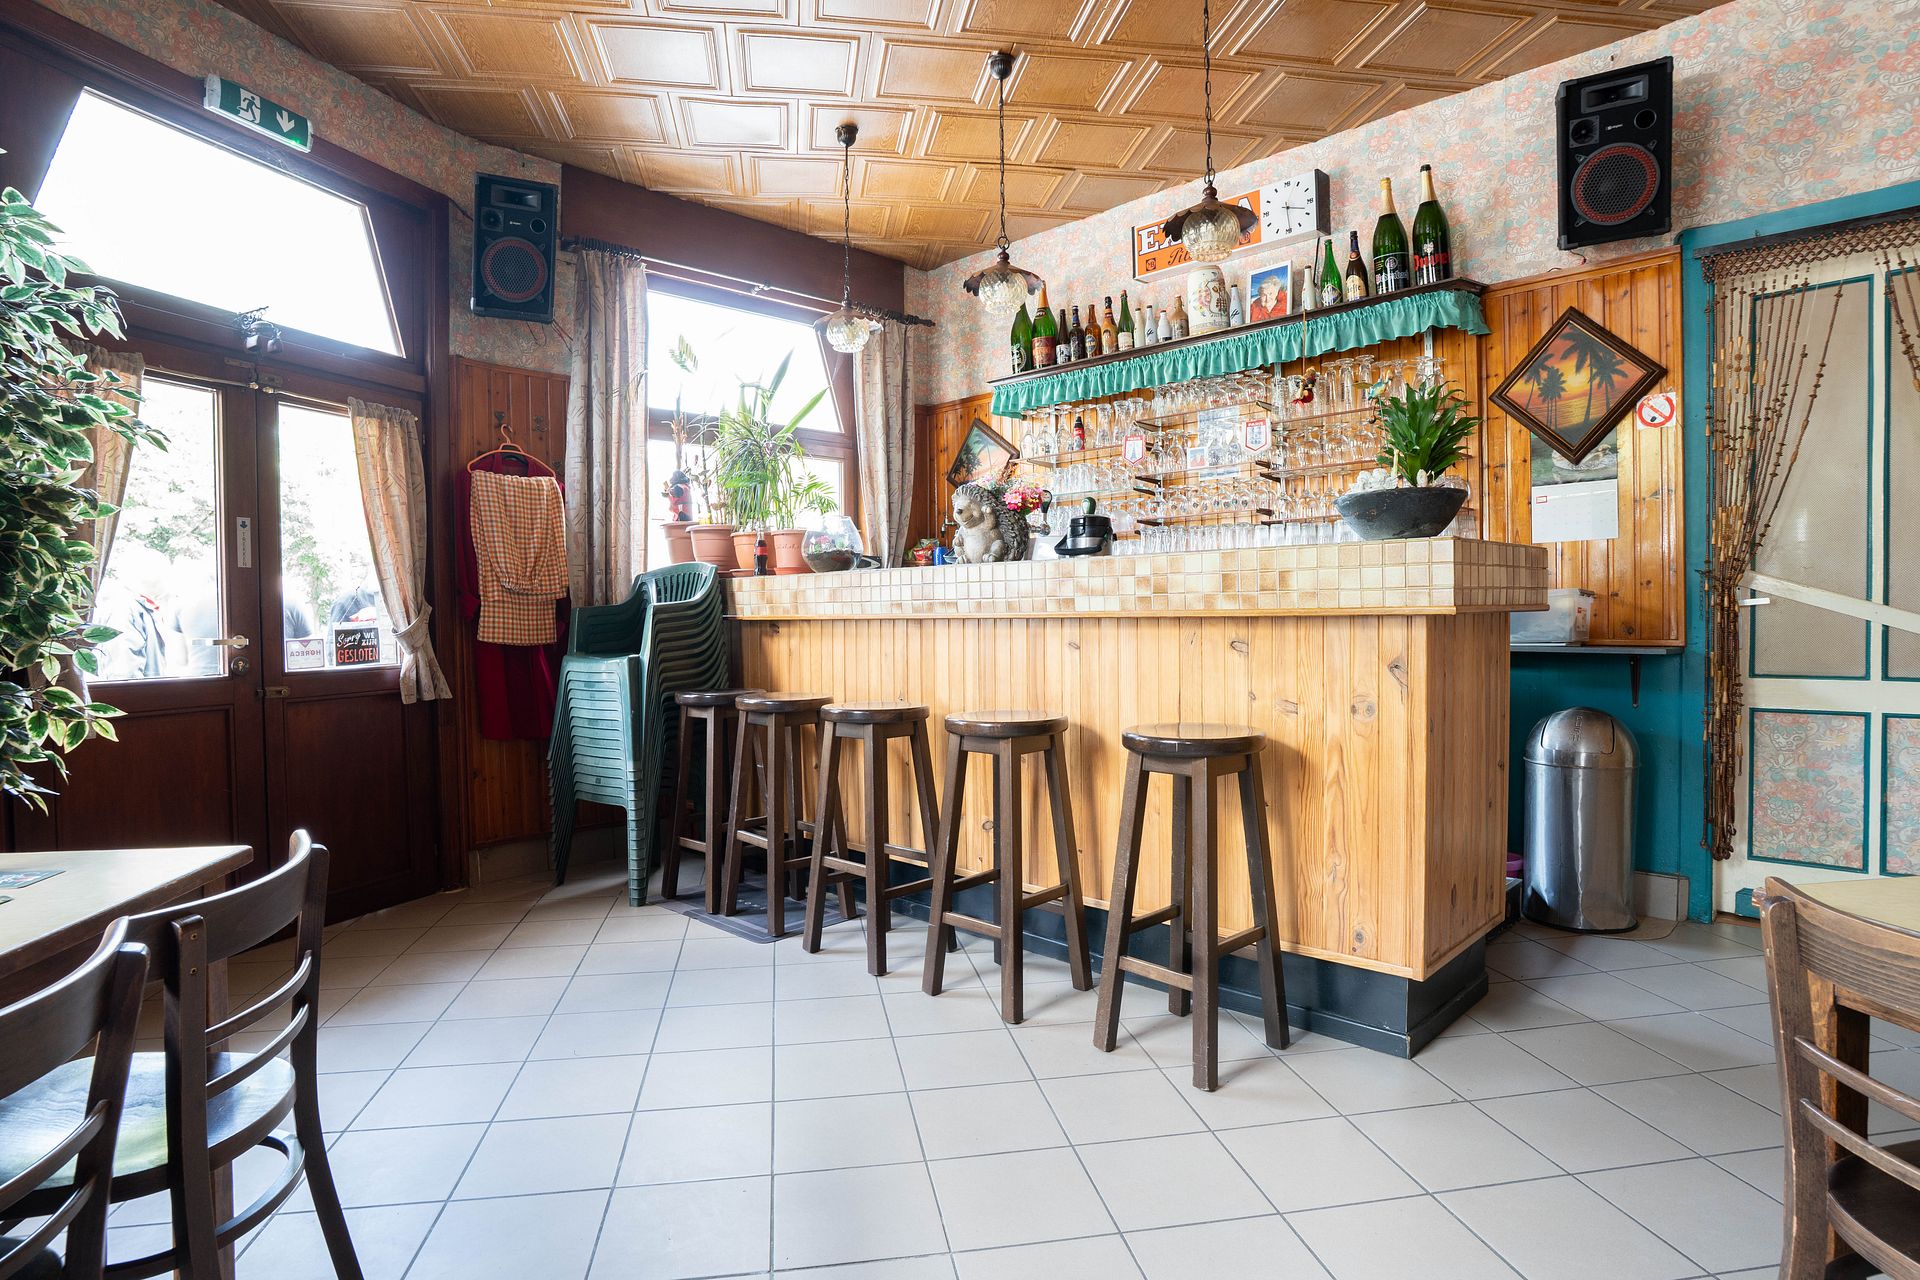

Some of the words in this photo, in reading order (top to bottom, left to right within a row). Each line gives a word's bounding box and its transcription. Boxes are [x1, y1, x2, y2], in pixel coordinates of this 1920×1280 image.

[336, 632, 361, 648] Sorry
[363, 631, 375, 639] WE
[361, 638, 377, 646] ZIJN
[337, 647, 379, 663] GESLOTEN
